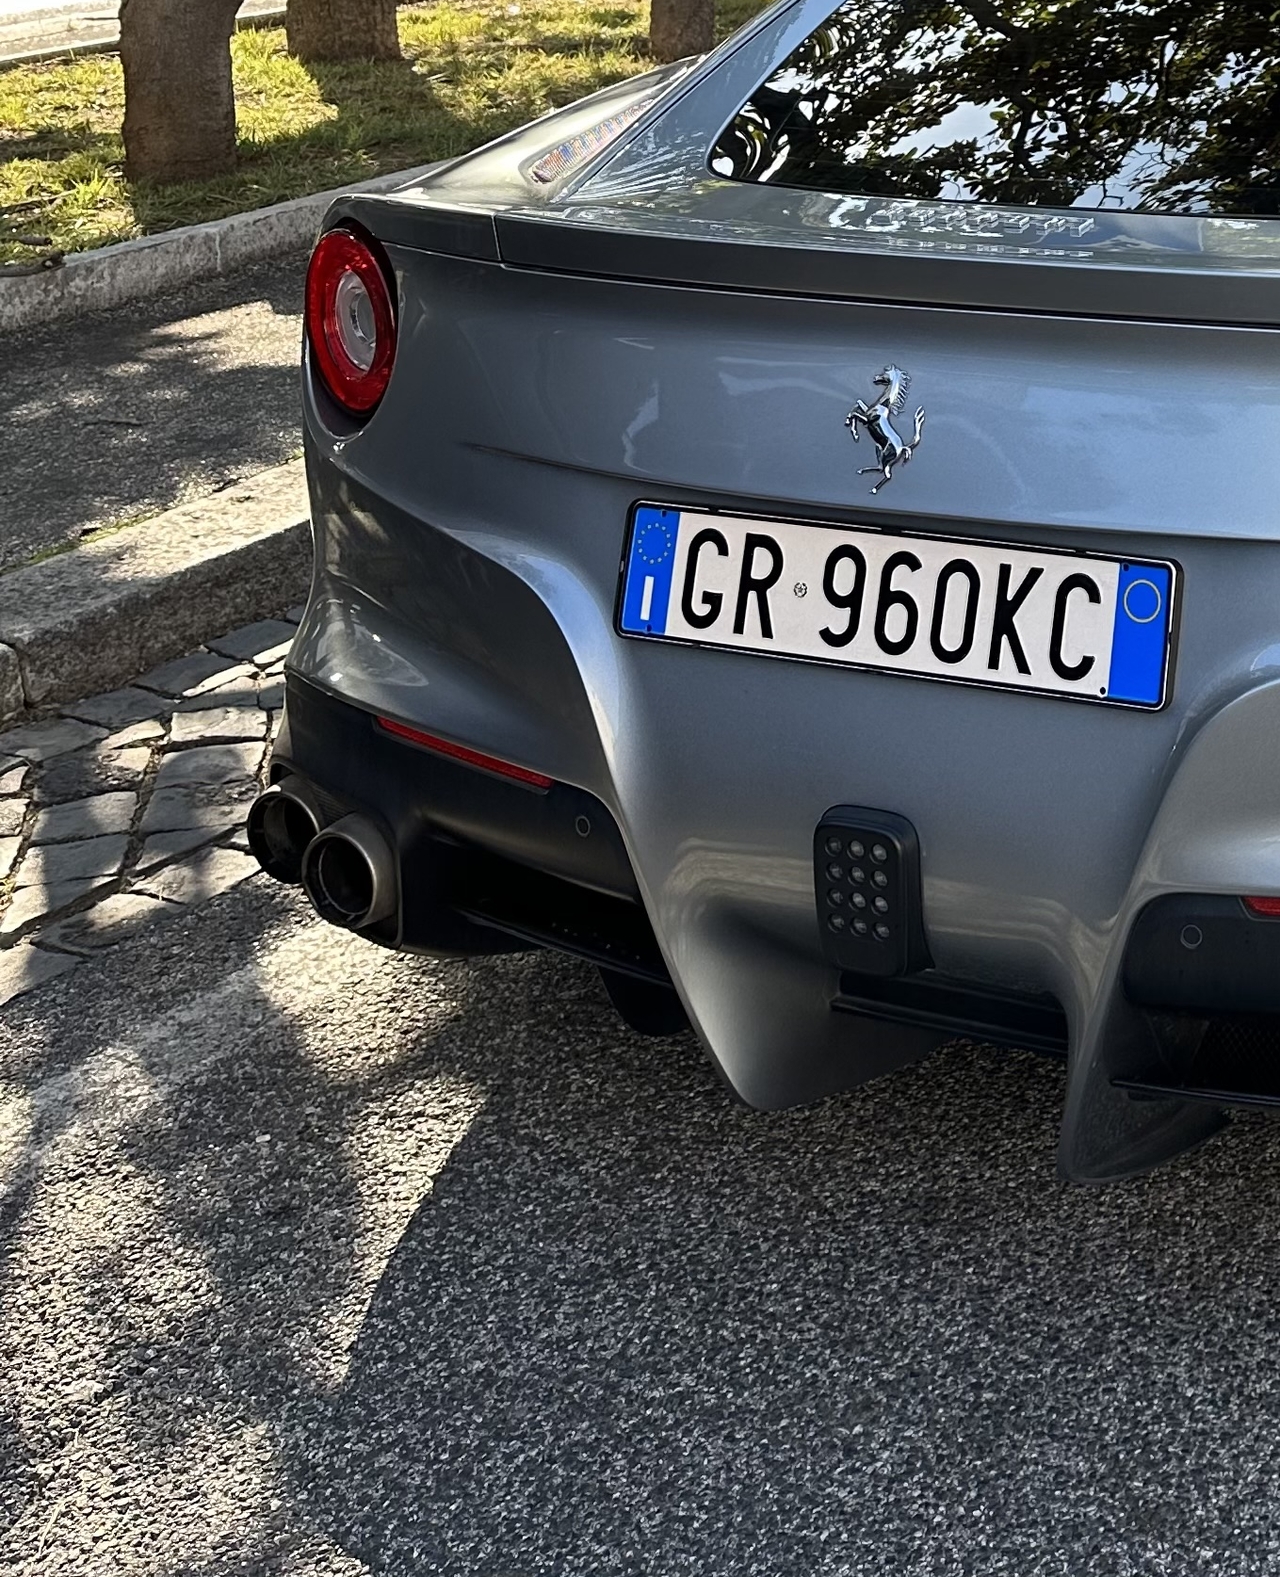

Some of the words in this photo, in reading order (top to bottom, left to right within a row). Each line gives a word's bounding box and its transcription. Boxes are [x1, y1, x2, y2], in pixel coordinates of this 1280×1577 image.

[640, 576, 653, 620] I
[681, 528, 784, 639] GR
[818, 544, 1101, 681] 960KC
